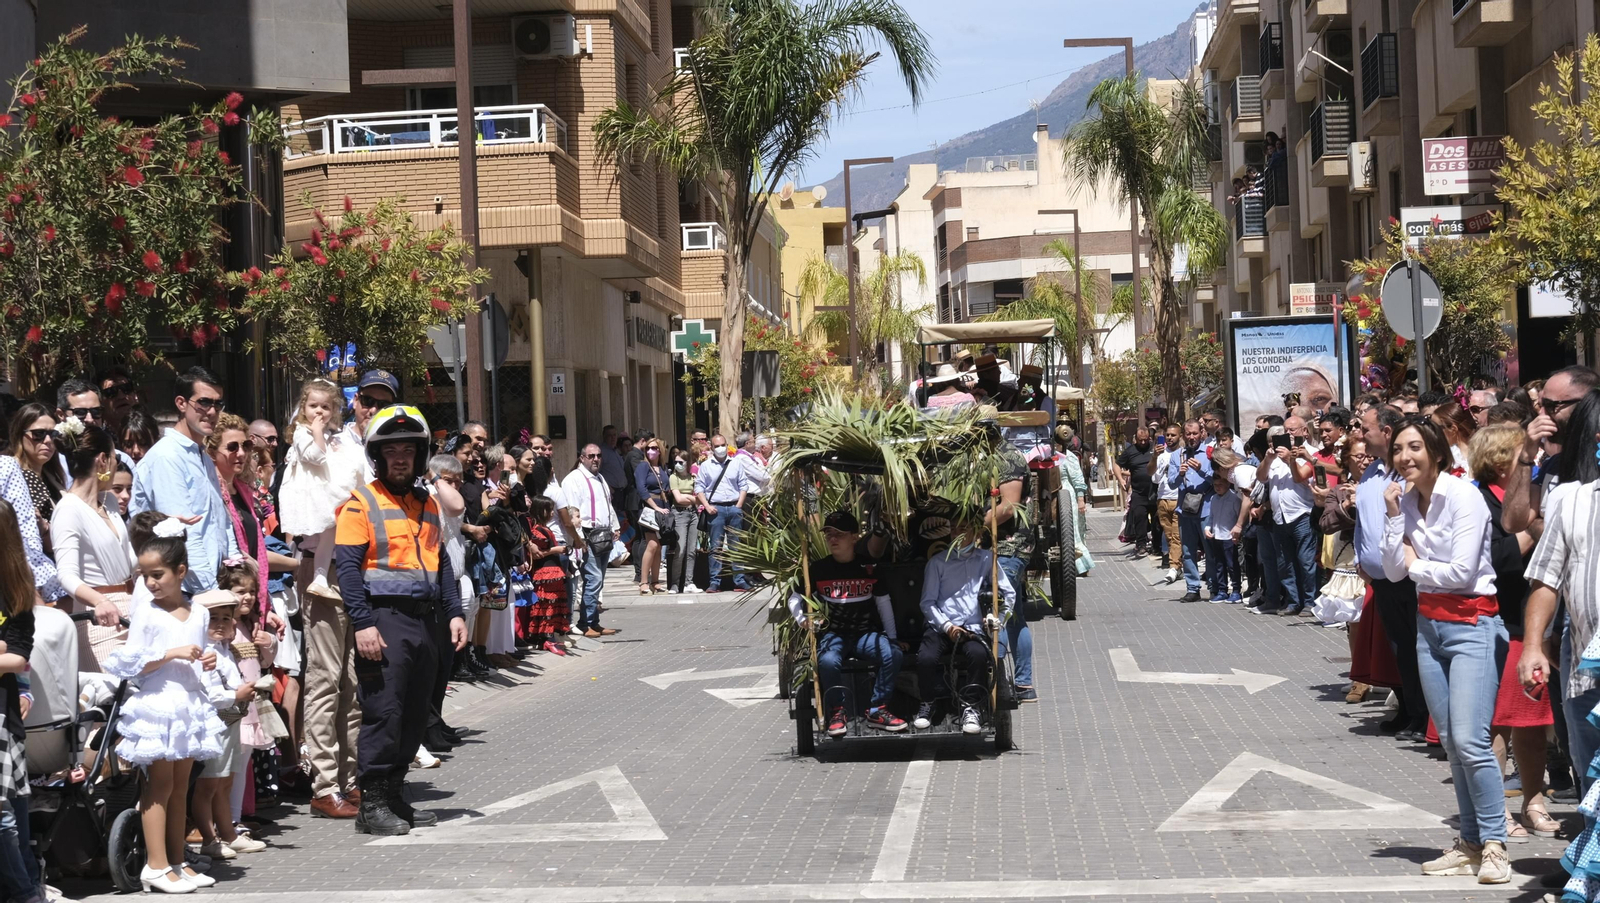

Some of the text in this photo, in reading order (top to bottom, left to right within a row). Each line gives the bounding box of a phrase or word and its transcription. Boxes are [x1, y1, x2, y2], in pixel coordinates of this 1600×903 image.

[1429, 143, 1465, 159] Dos
[1429, 160, 1501, 171] ASESORIA
[1469, 212, 1494, 231] ejid
[1241, 345, 1328, 356] NUESTRA INDIFERENCIA
[1242, 356, 1293, 365] LOS CONDENA
[1242, 365, 1281, 374] AL OLVIDO
[823, 583, 873, 597] BULLS
